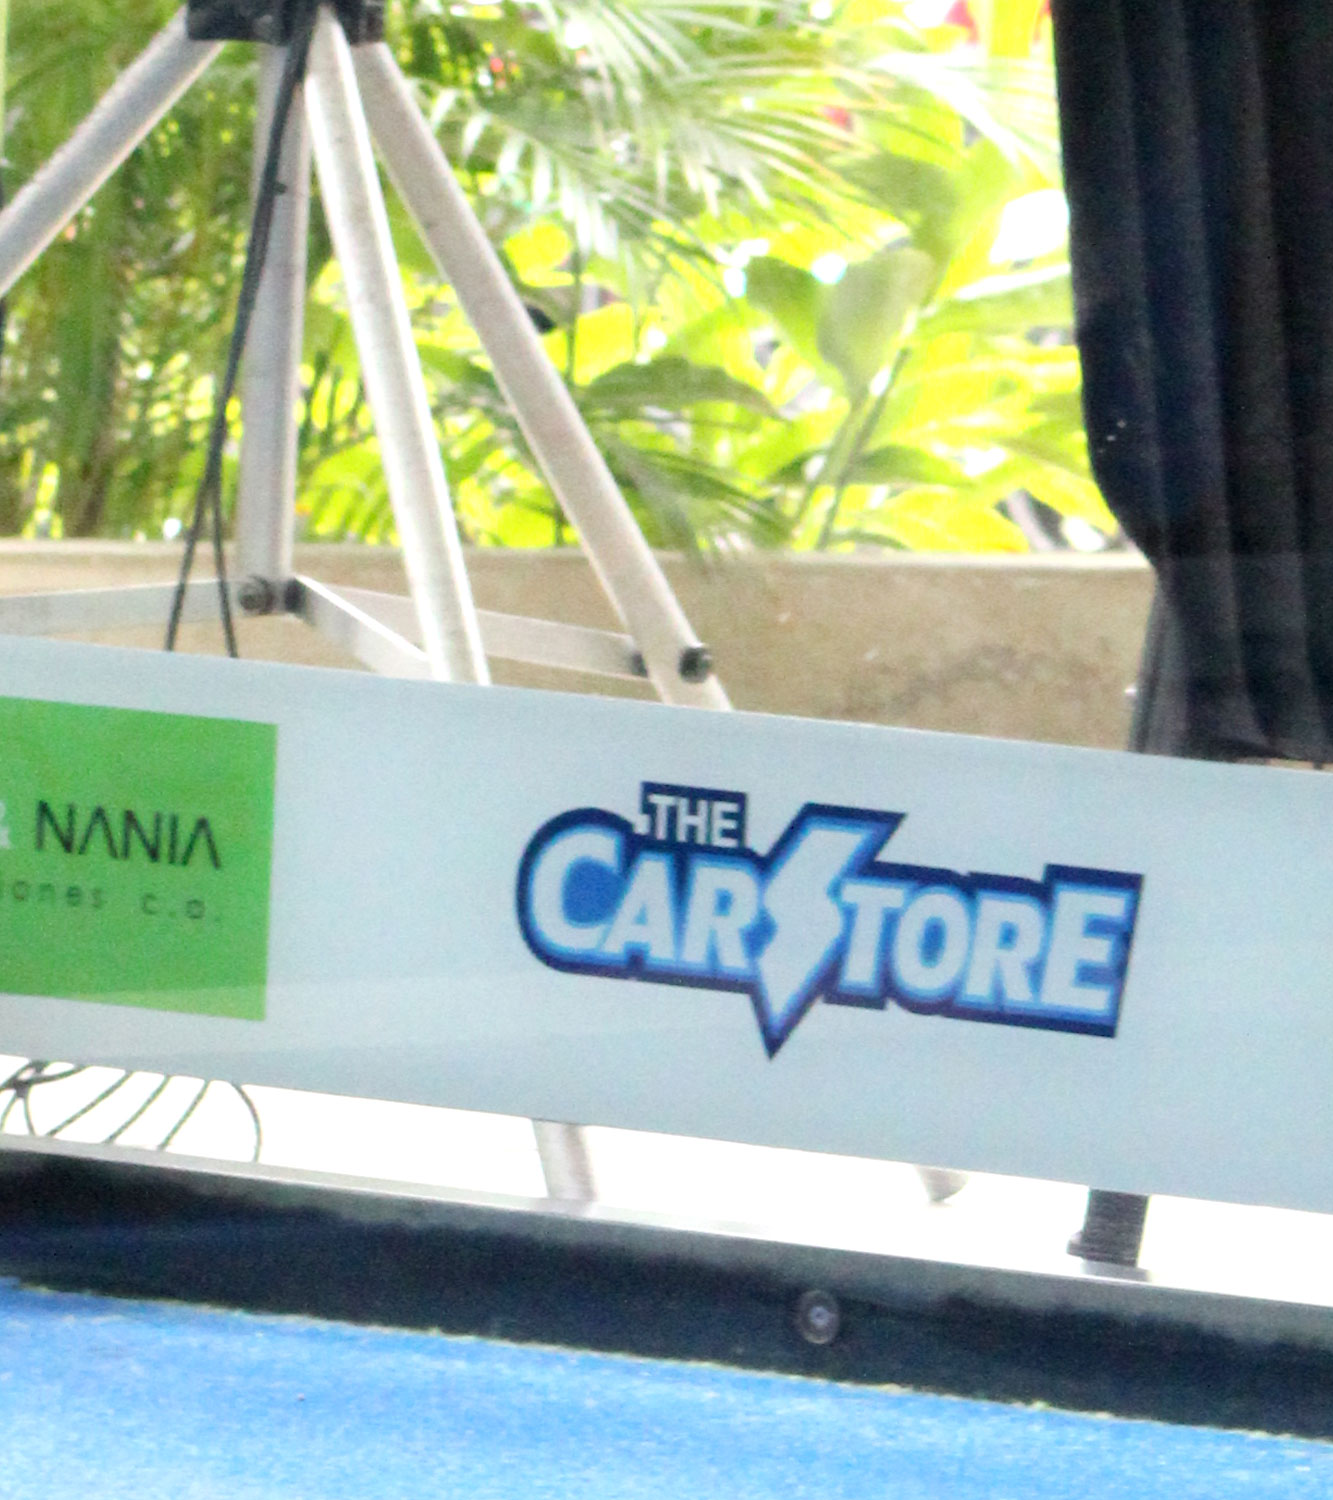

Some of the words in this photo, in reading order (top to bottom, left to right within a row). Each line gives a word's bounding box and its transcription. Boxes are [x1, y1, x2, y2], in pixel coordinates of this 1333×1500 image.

[36, 800, 221, 870] NANIA
[642, 788, 745, 849] THE
[516, 804, 1145, 1060] CARSTORE
